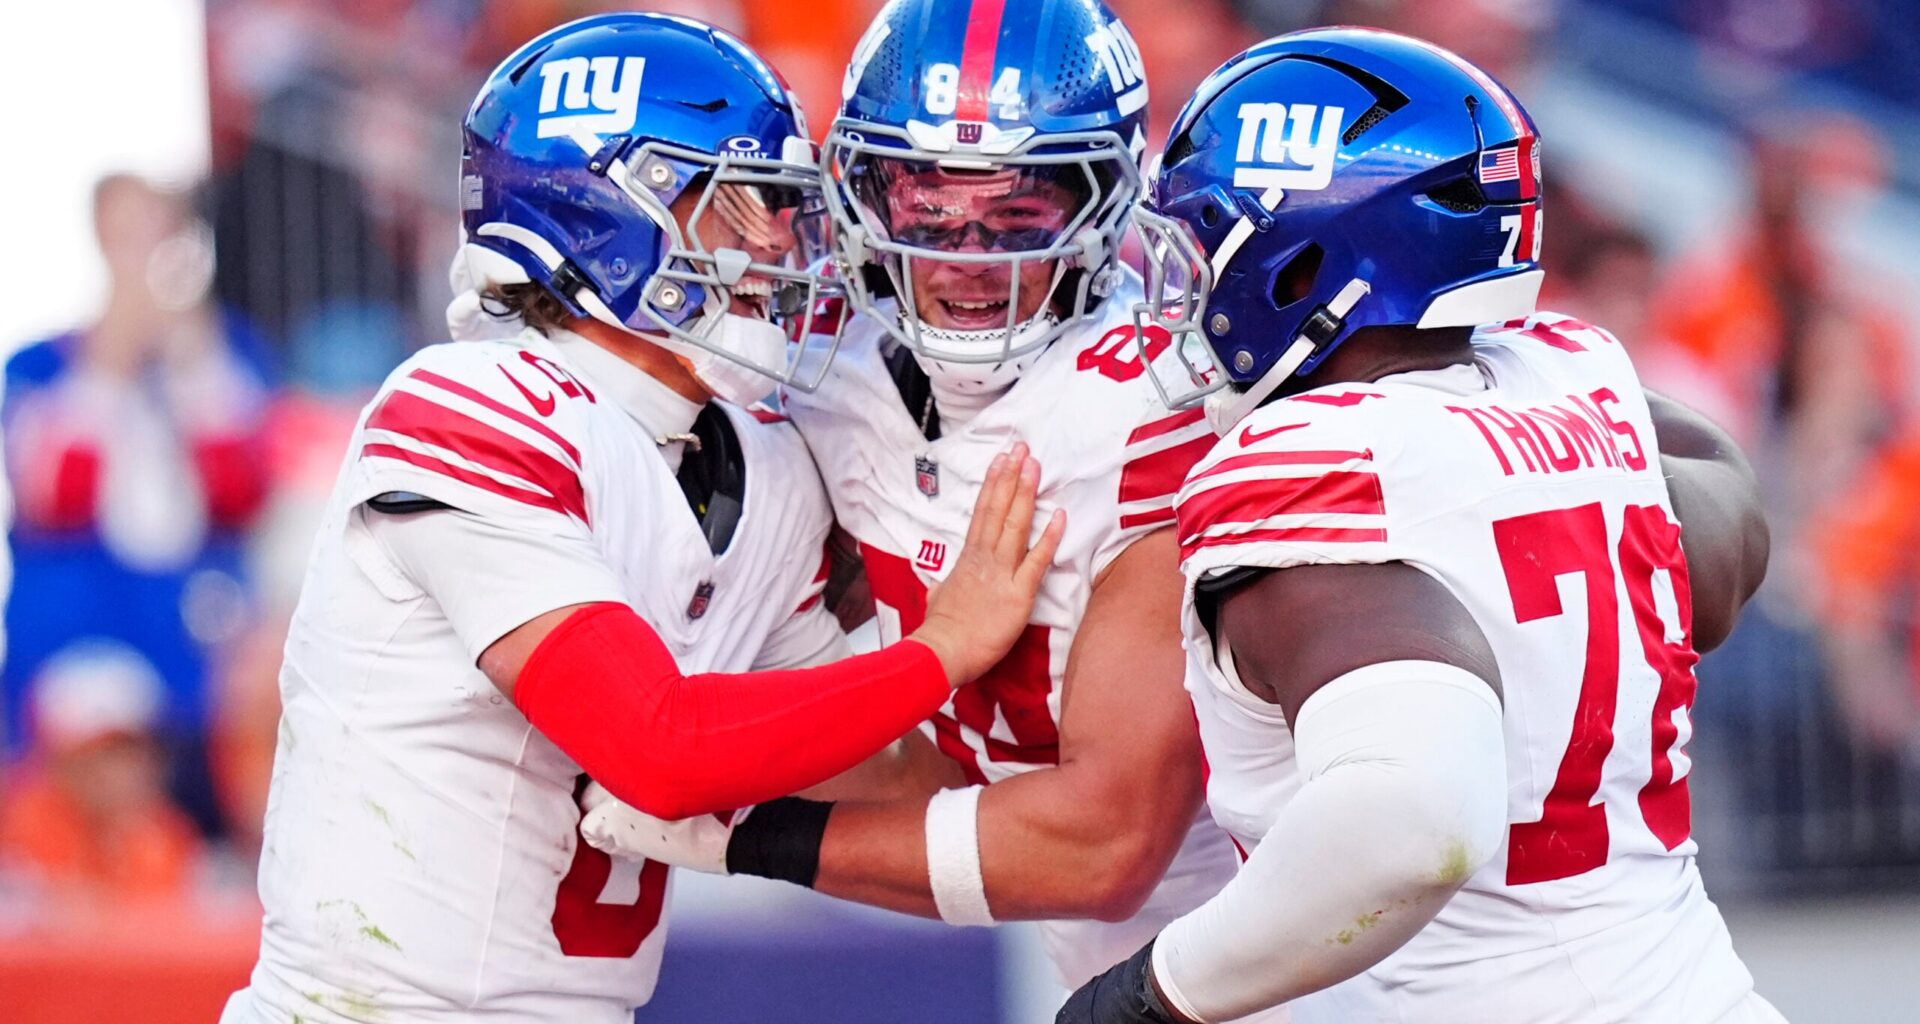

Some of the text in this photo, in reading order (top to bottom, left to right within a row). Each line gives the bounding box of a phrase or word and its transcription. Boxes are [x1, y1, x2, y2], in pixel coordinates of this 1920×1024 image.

[537, 56, 646, 139] ny
[925, 63, 1022, 120] 84
[956, 122, 983, 145] ny
[1233, 102, 1344, 190] ny
[1444, 387, 1647, 476] THOMAS
[915, 540, 947, 572] ny
[1493, 501, 1700, 886] 78
